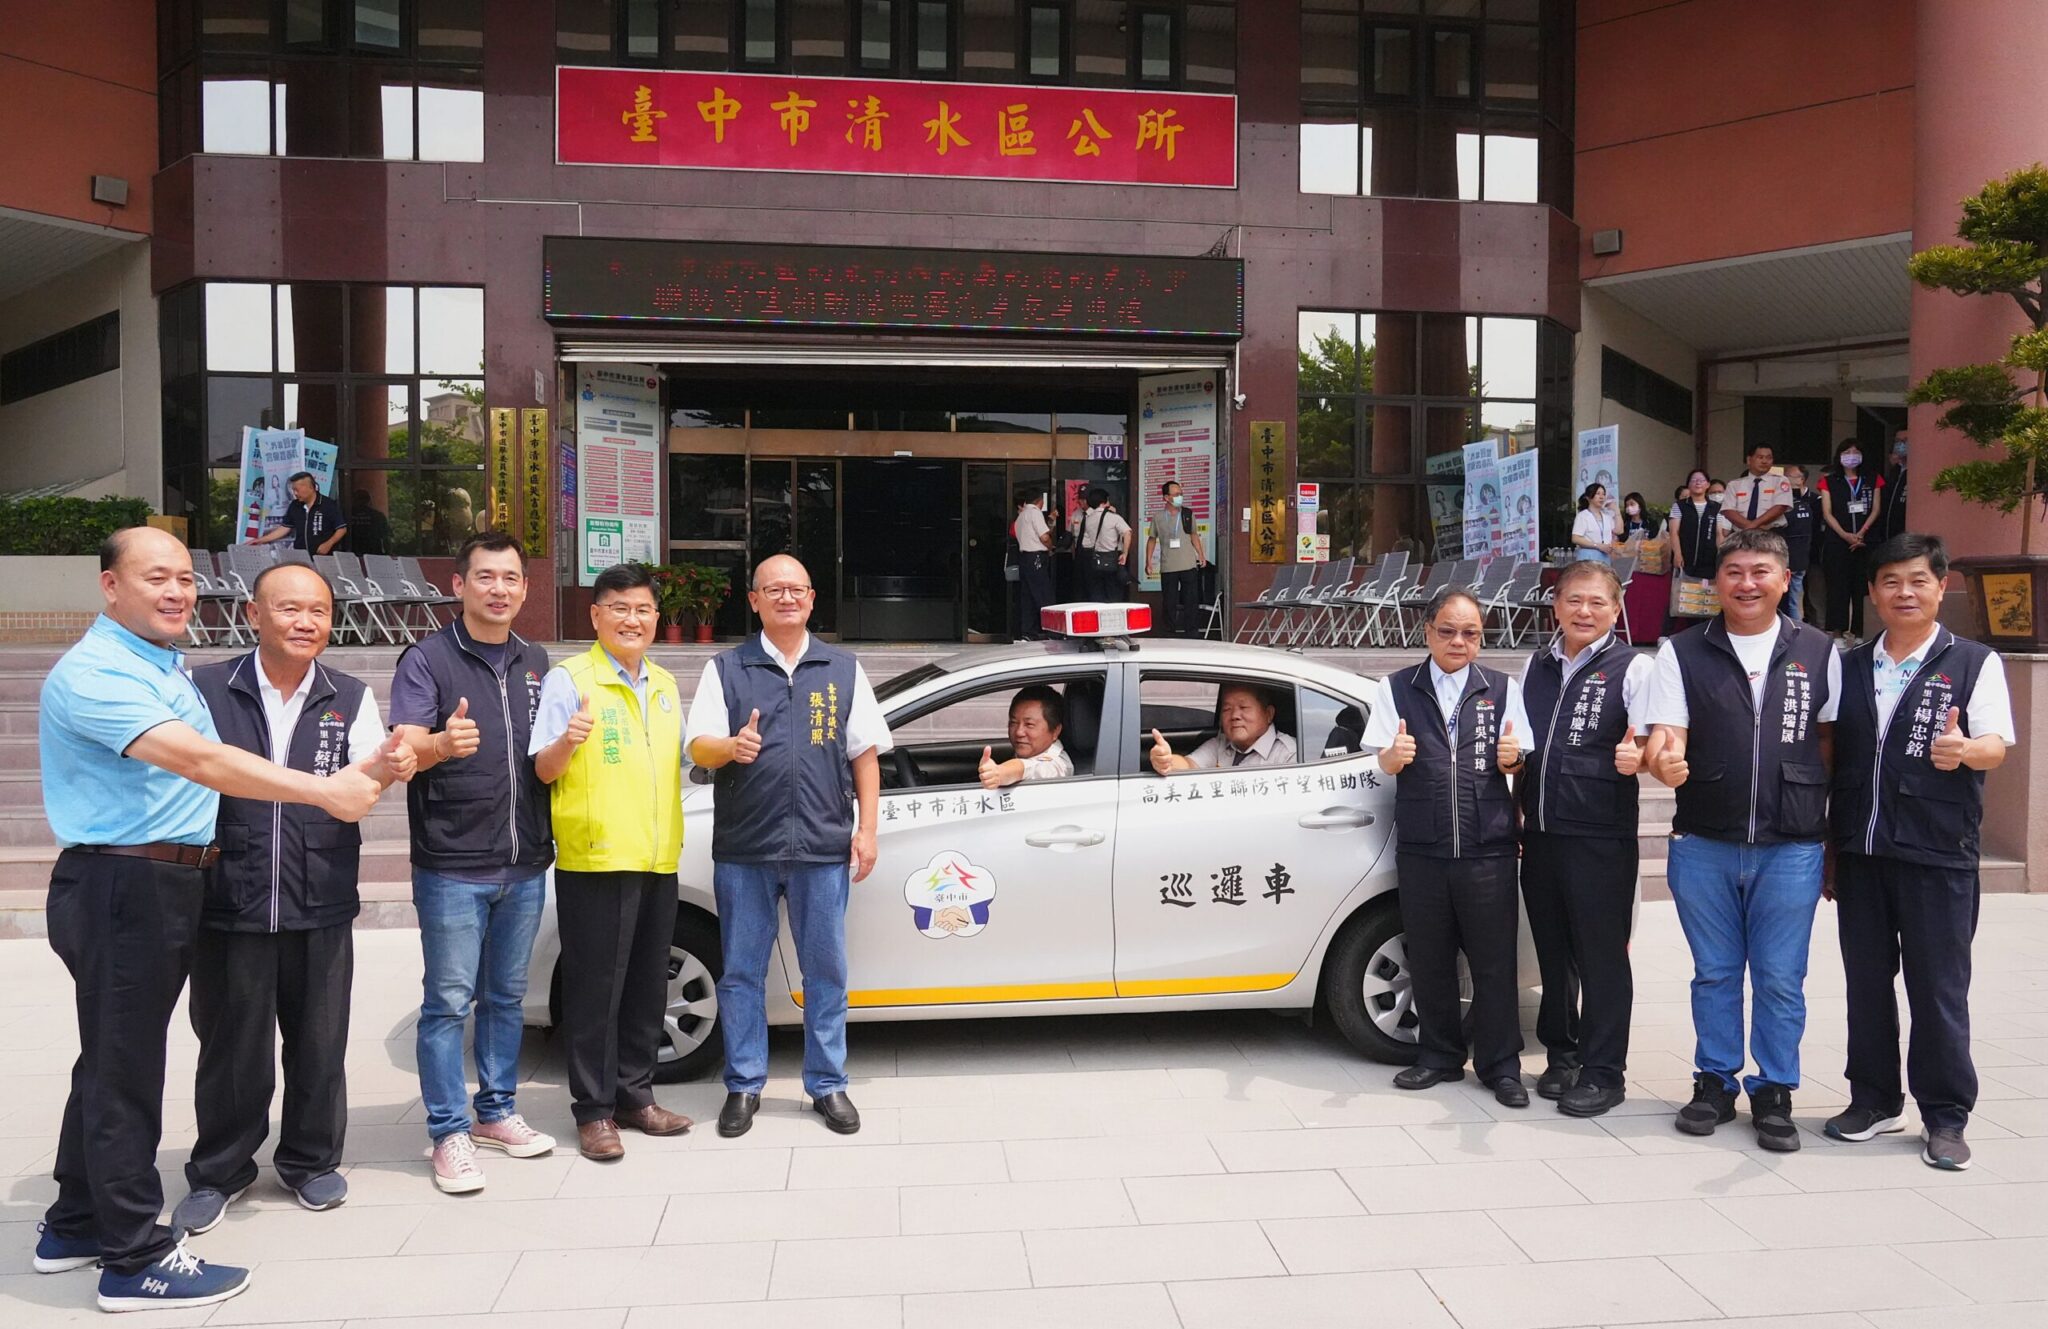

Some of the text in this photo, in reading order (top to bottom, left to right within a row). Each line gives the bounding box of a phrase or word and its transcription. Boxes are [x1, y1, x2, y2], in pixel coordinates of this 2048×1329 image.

[621, 85, 1186, 162] 臺中市清水區公所
[1096, 445, 1121, 459] 101
[1260, 427, 1276, 557] 臺中市清水區公所
[810, 692, 826, 746] 張清照
[1142, 769, 1381, 804] 高美五里聯防守望相助隊
[881, 793, 1017, 821] 臺中市清水區
[934, 893, 968, 902] 臺中市
[1159, 862, 1296, 908] 巡邏車
[141, 1277, 169, 1295] HH
